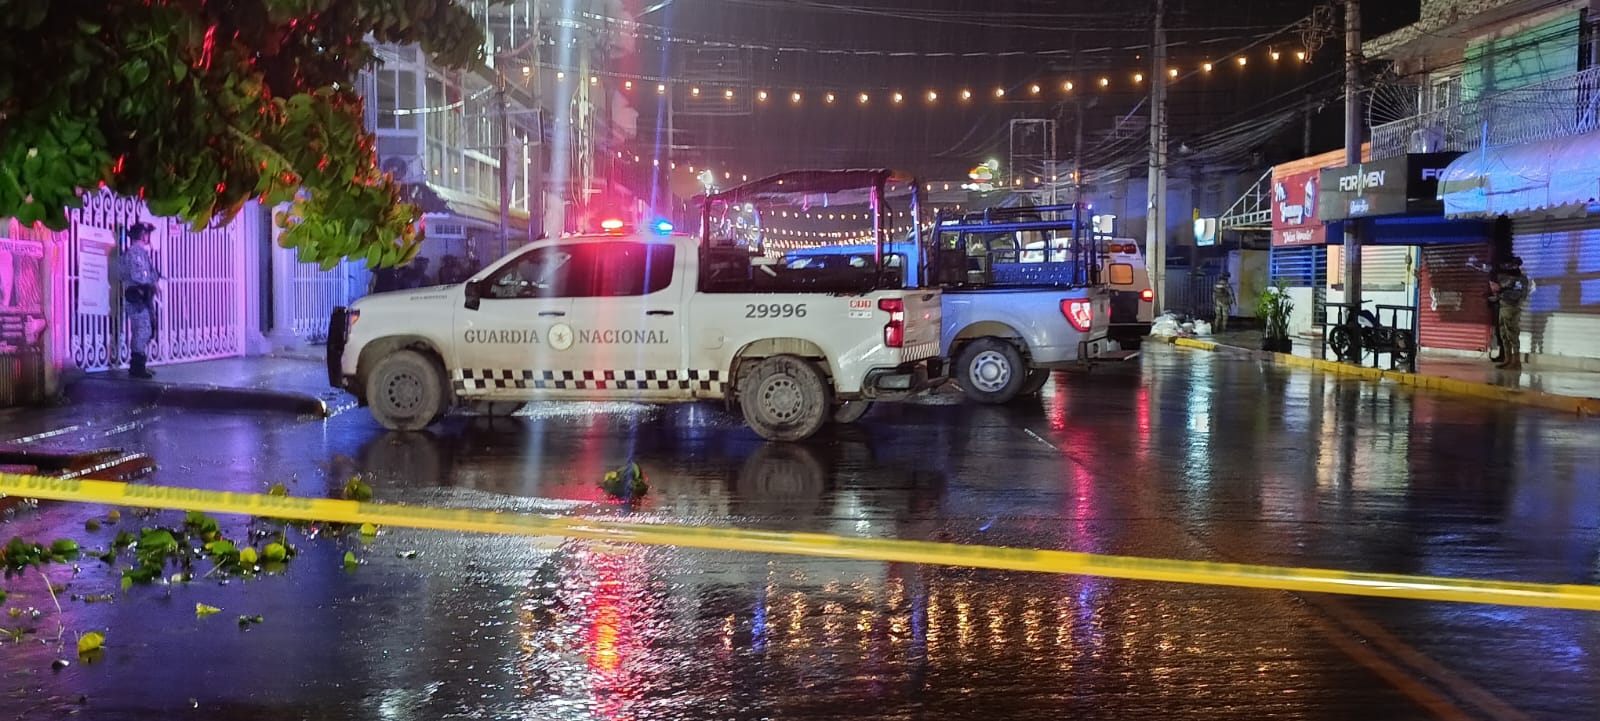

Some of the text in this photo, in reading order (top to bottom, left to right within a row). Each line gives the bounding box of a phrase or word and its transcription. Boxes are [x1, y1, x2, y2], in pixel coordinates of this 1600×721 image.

[1339, 169, 1385, 192] FOR MEN
[745, 303, 807, 318] 29996
[464, 329, 669, 345] GUARDIA NACIONAL
